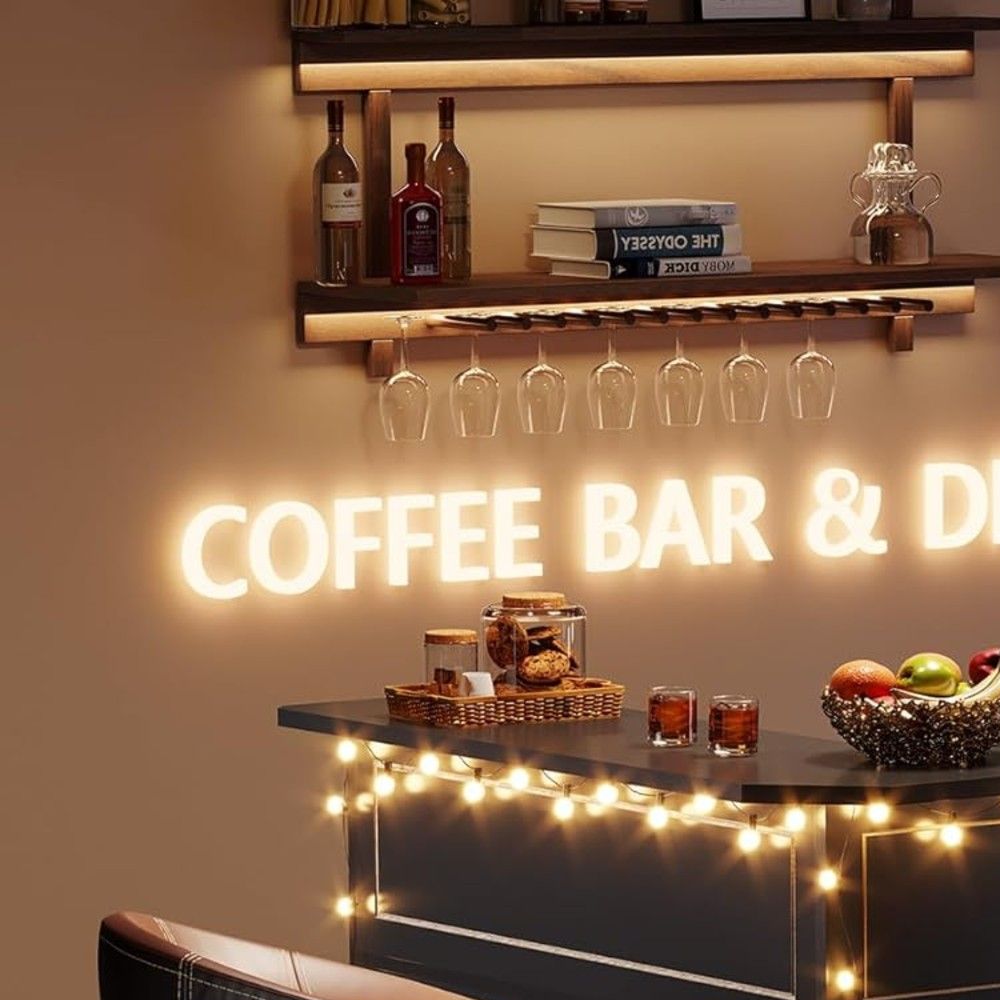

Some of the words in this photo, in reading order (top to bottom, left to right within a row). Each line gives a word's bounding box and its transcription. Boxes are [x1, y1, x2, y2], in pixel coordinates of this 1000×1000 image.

[180, 487, 544, 600] COFFEE
[583, 474, 774, 573] BAR
[804, 467, 889, 558] &
